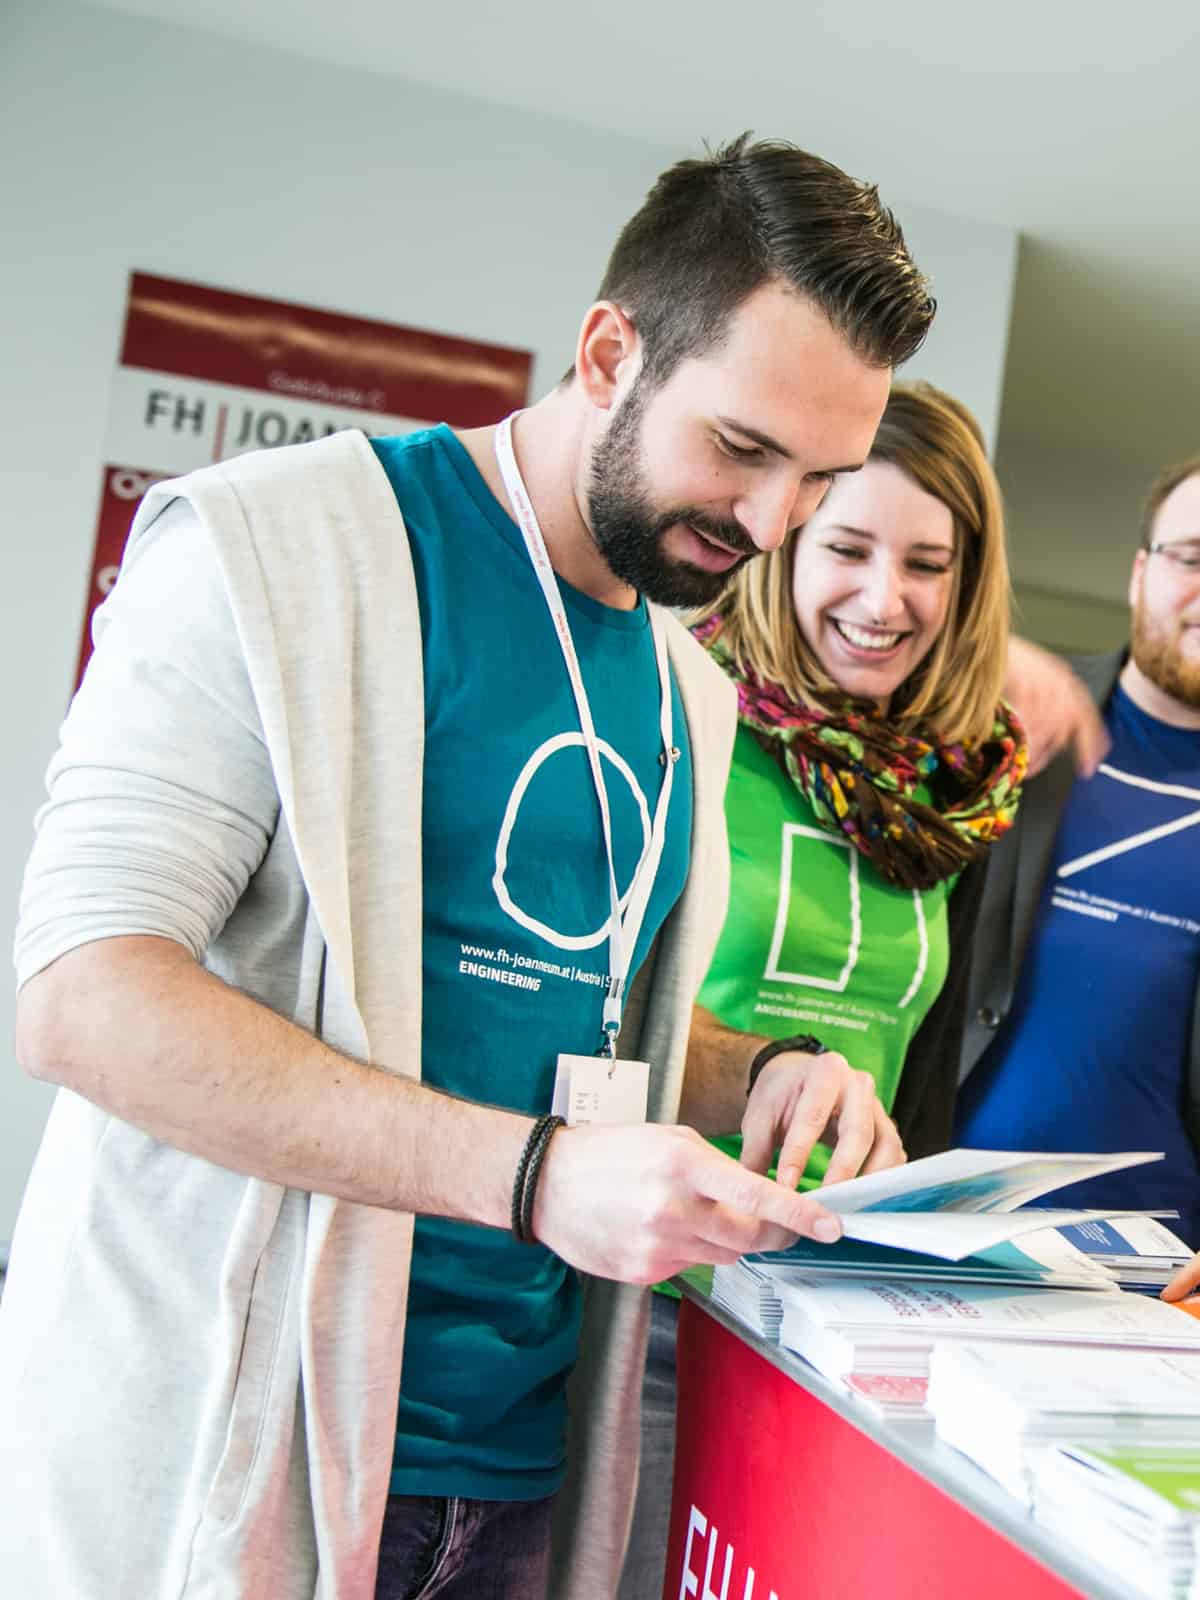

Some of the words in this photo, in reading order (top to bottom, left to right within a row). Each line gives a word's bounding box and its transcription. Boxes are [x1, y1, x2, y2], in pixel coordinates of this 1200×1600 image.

[145, 390, 205, 434] FH
[459, 960, 542, 992] ENGINEERING
[460, 943, 570, 979] www.fh-joanneum.at
